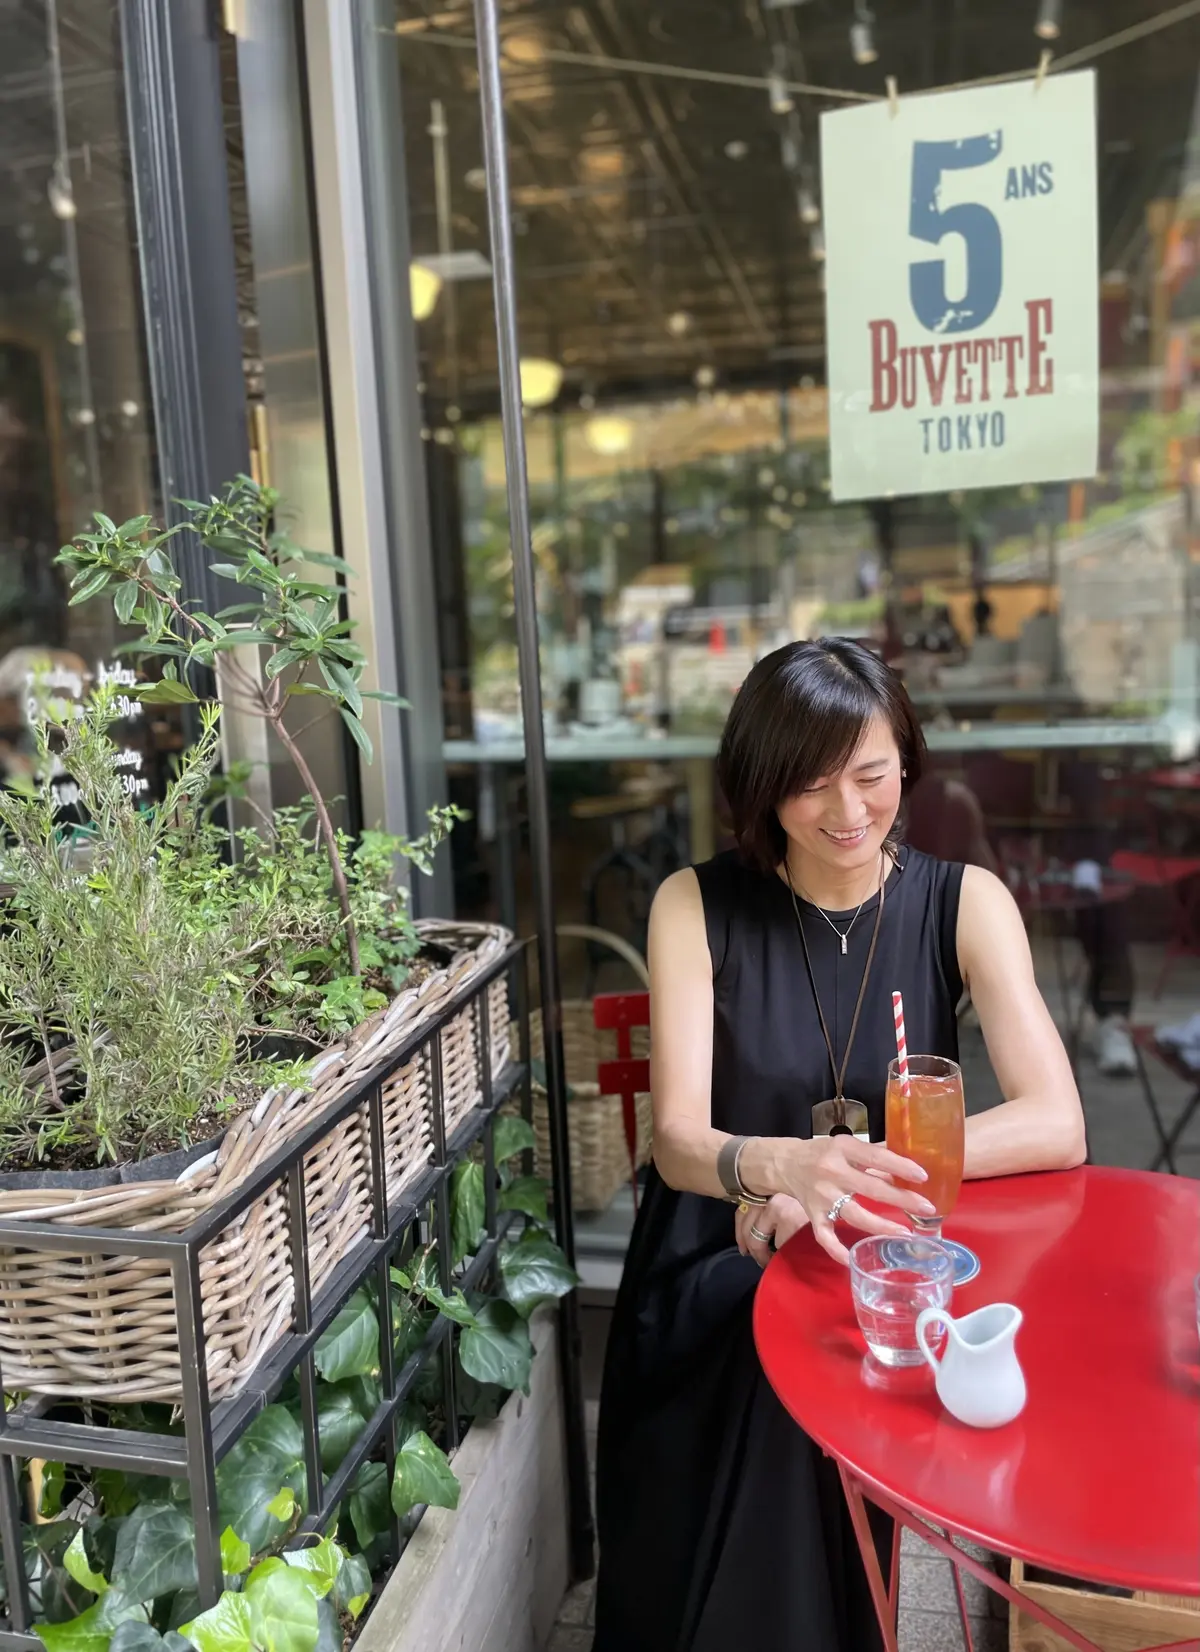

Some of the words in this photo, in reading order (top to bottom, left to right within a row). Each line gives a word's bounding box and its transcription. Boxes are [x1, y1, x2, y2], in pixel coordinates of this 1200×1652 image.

[908, 128, 1003, 334] 5
[1005, 162, 1054, 201] ANS
[919, 411, 1006, 454] TOKYO
